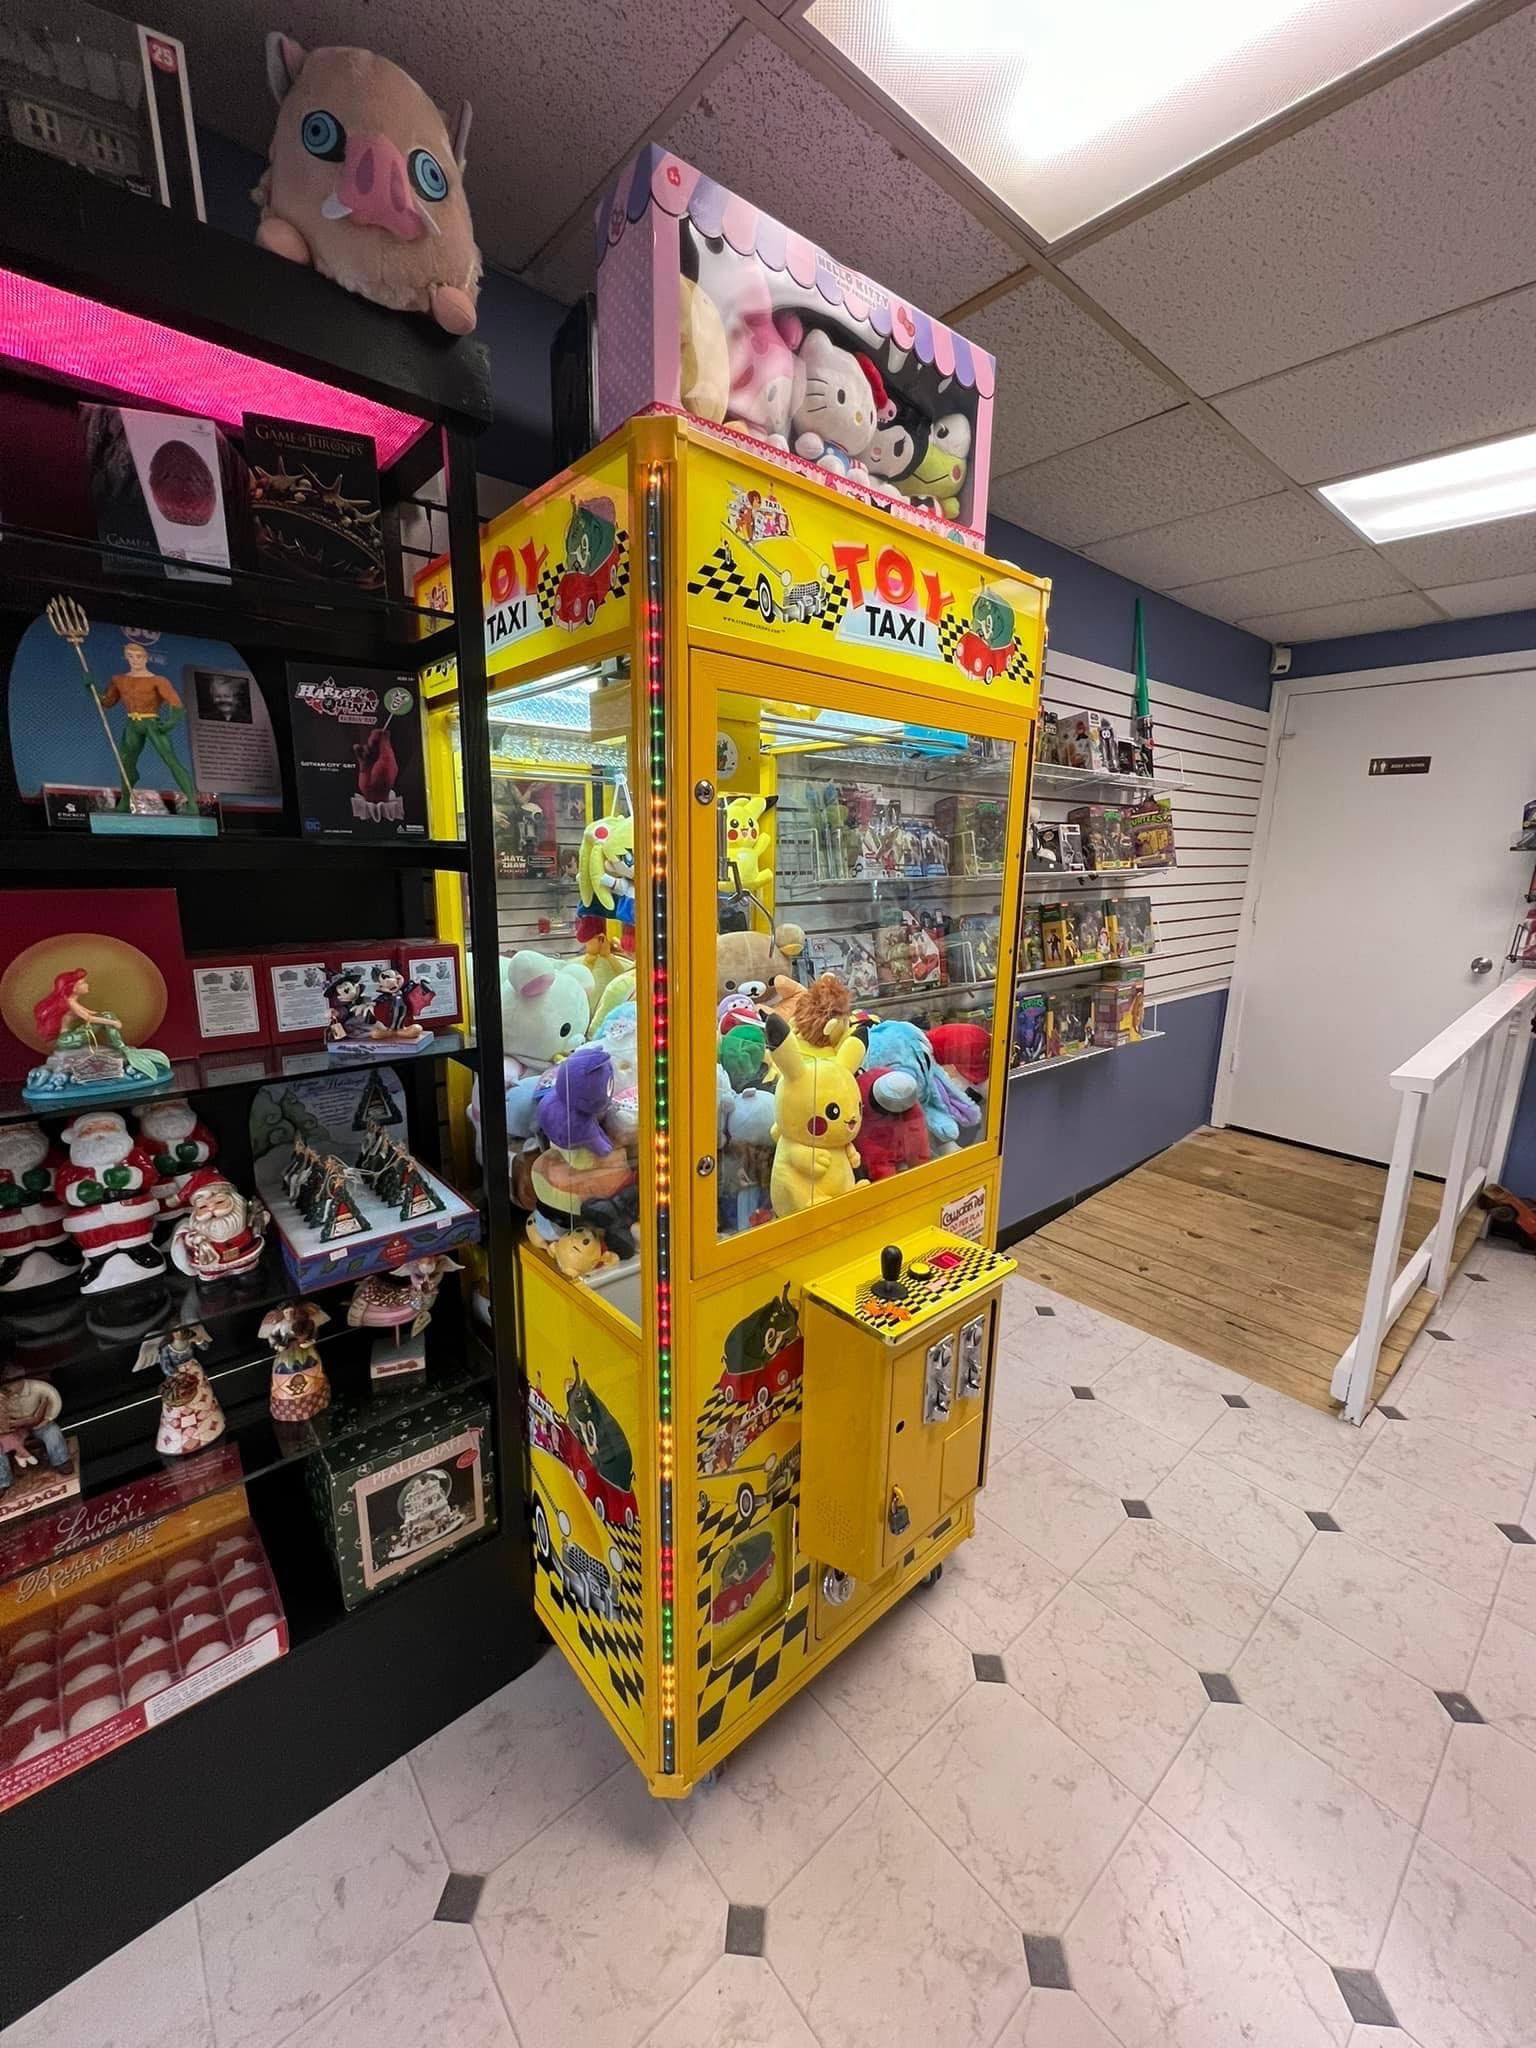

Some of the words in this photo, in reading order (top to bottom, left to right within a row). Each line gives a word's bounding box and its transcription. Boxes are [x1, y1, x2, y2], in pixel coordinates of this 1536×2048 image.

[817, 255, 853, 285] HELLO
[855, 279, 889, 307] KITTY
[255, 424, 299, 443] GAME
[304, 432, 365, 455] THRONES
[765, 500, 781, 510] TAXI
[481, 536, 550, 603] OY
[832, 541, 956, 625] TOY
[487, 600, 528, 645] TAXI
[865, 605, 925, 647] TAXI
[297, 683, 362, 699] HARLEY
[372, 1437, 464, 1486] PFALTZGRAFF
[60, 1532, 153, 1589] CHANCEUSE
[100, 1540, 119, 1555] DE
